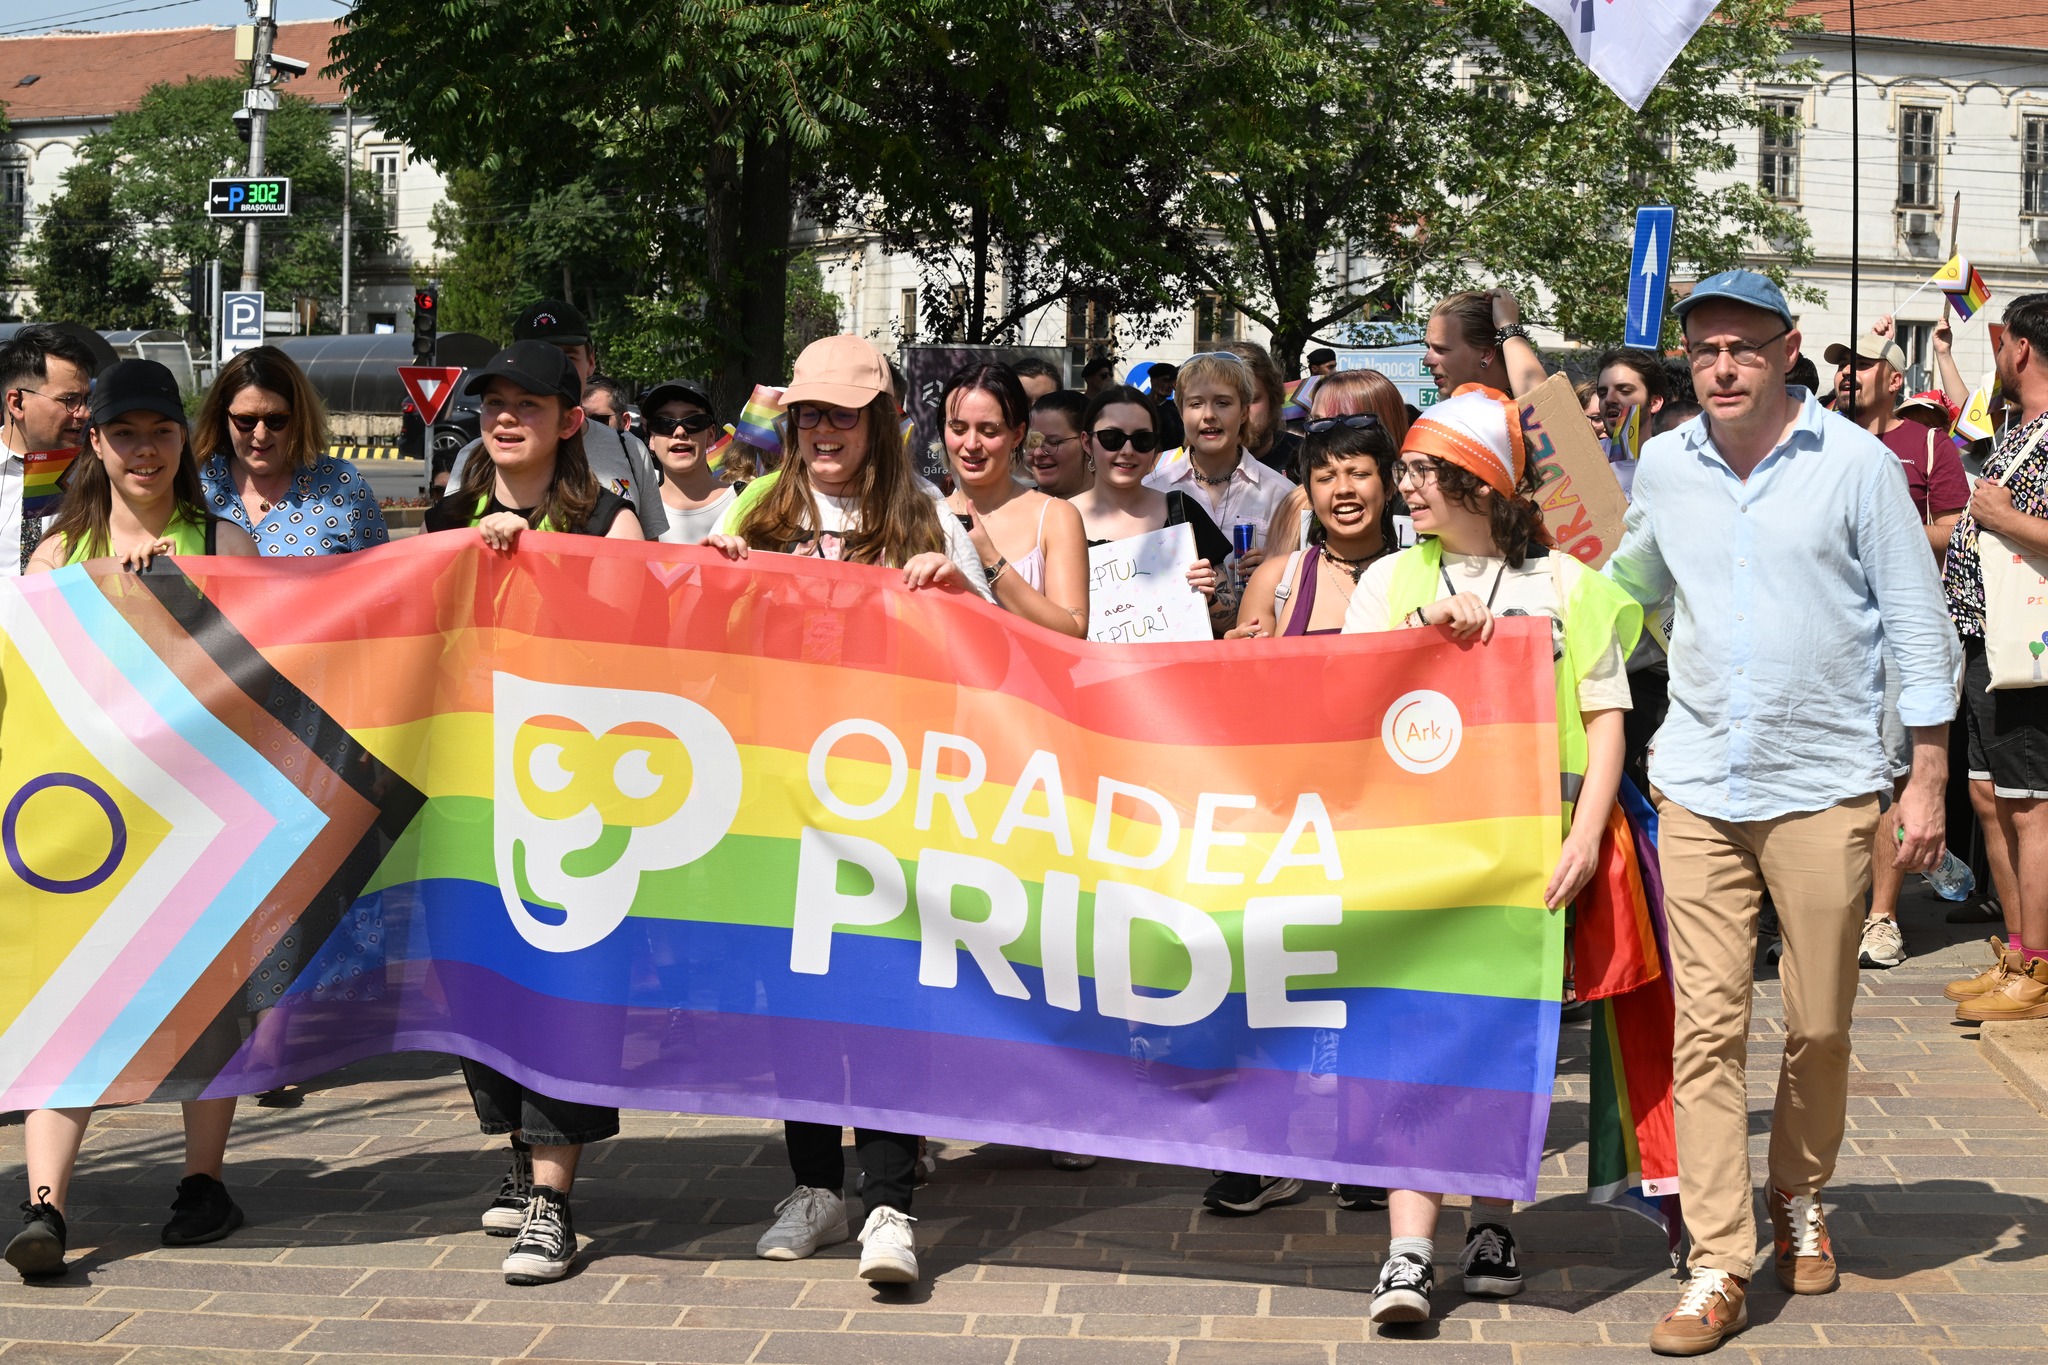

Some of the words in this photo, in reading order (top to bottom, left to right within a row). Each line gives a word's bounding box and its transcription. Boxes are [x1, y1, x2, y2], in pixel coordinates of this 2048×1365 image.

[228, 186, 245, 212] P
[248, 183, 279, 203] 302
[241, 203, 285, 212] BRAȘOVULUI
[231, 304, 256, 336] P
[1365, 357, 1416, 377] Napoca
[923, 466, 951, 477] gara
[1104, 602, 1135, 617] avea
[1406, 719, 1442, 743] Ark
[806, 717, 1345, 886] ORADEA
[789, 825, 1348, 1030] PRIDE
